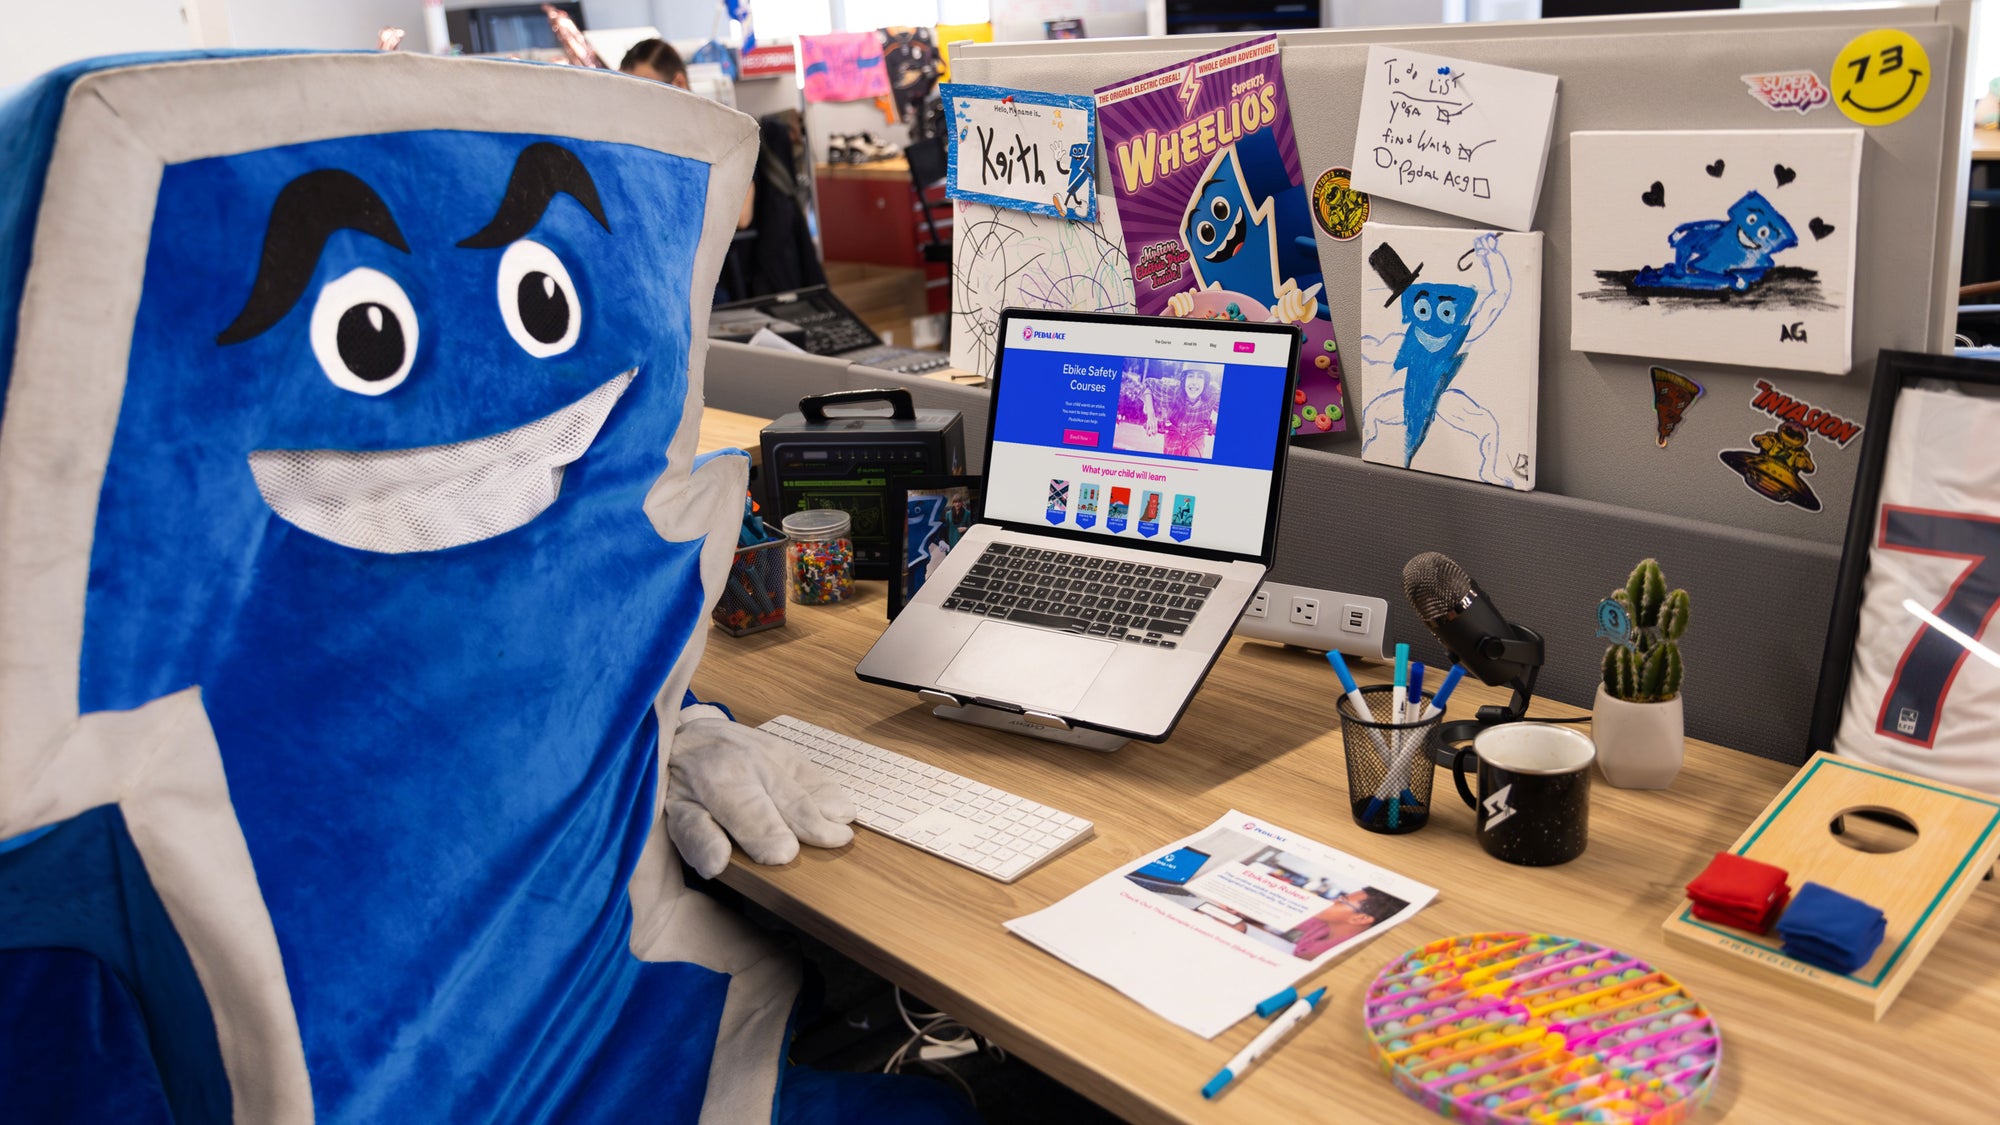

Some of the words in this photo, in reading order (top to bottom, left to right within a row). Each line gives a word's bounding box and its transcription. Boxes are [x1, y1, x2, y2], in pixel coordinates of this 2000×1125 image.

[1199, 61, 1219, 73] WHOLE
[1219, 55, 1237, 67] GRAIN
[1238, 43, 1275, 62] ADVENTURE!
[1384, 58, 1400, 85] To
[1848, 45, 1904, 84] 73
[1099, 94, 1109, 104] THE
[1110, 87, 1134, 100] ORIGINAL
[1134, 79, 1158, 93] ELECTRIC
[1159, 72, 1181, 85] CEREAL!
[1232, 73, 1265, 97] SUPER73
[1761, 75, 1813, 91] SUPER
[1117, 84, 1277, 193] WHEELIOS
[977, 125, 1046, 185] Keith
[1314, 170, 1335, 198] SECTOR73
[1341, 230, 1353, 238] THE
[1780, 321, 1808, 344] AG
[1062, 363, 1087, 376] Ebike
[1088, 365, 1118, 380] Safety
[1070, 379, 1106, 392] Courses
[1752, 391, 1861, 445] INVASION
[1082, 464, 1101, 474] What
[1101, 467, 1117, 476] your
[1117, 468, 1135, 479] child
[1135, 471, 1148, 480] will
[1148, 473, 1166, 482] learn
[1609, 609, 1619, 628] 3
[1875, 503, 2000, 750] 7
